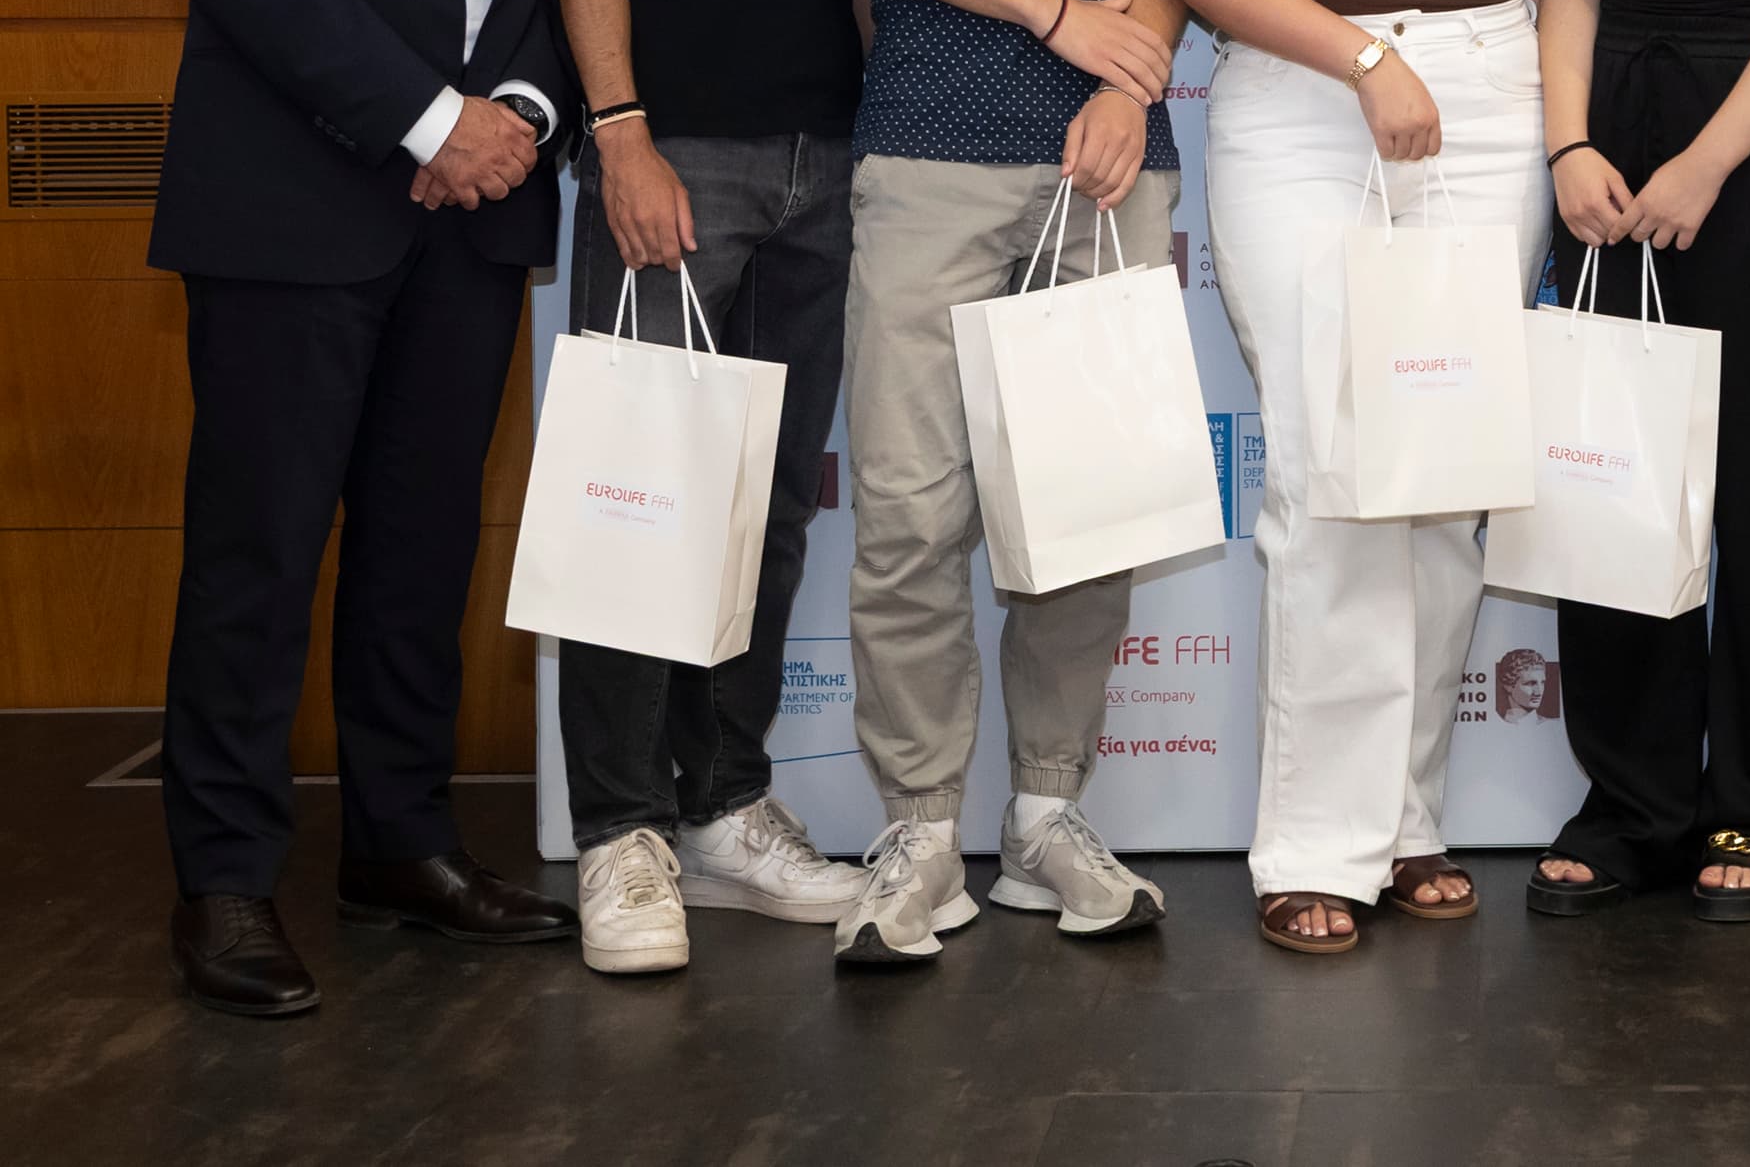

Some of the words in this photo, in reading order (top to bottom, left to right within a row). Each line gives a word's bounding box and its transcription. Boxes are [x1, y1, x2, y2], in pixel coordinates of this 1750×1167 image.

[1395, 359, 1447, 373] EUROLIFE
[1548, 446, 1604, 466] EUROLIFE
[586, 483, 647, 505] EUROLIFE
[1176, 636, 1229, 664] FFH
[782, 674, 846, 686] ΑΤΙΣΤΙΚΗΣ
[780, 693, 836, 703] PARTMENT
[1131, 690, 1195, 704] Company
[777, 705, 822, 714] ATISTICS
[1130, 742, 1160, 756] για
[1165, 735, 1216, 755] σένα;
